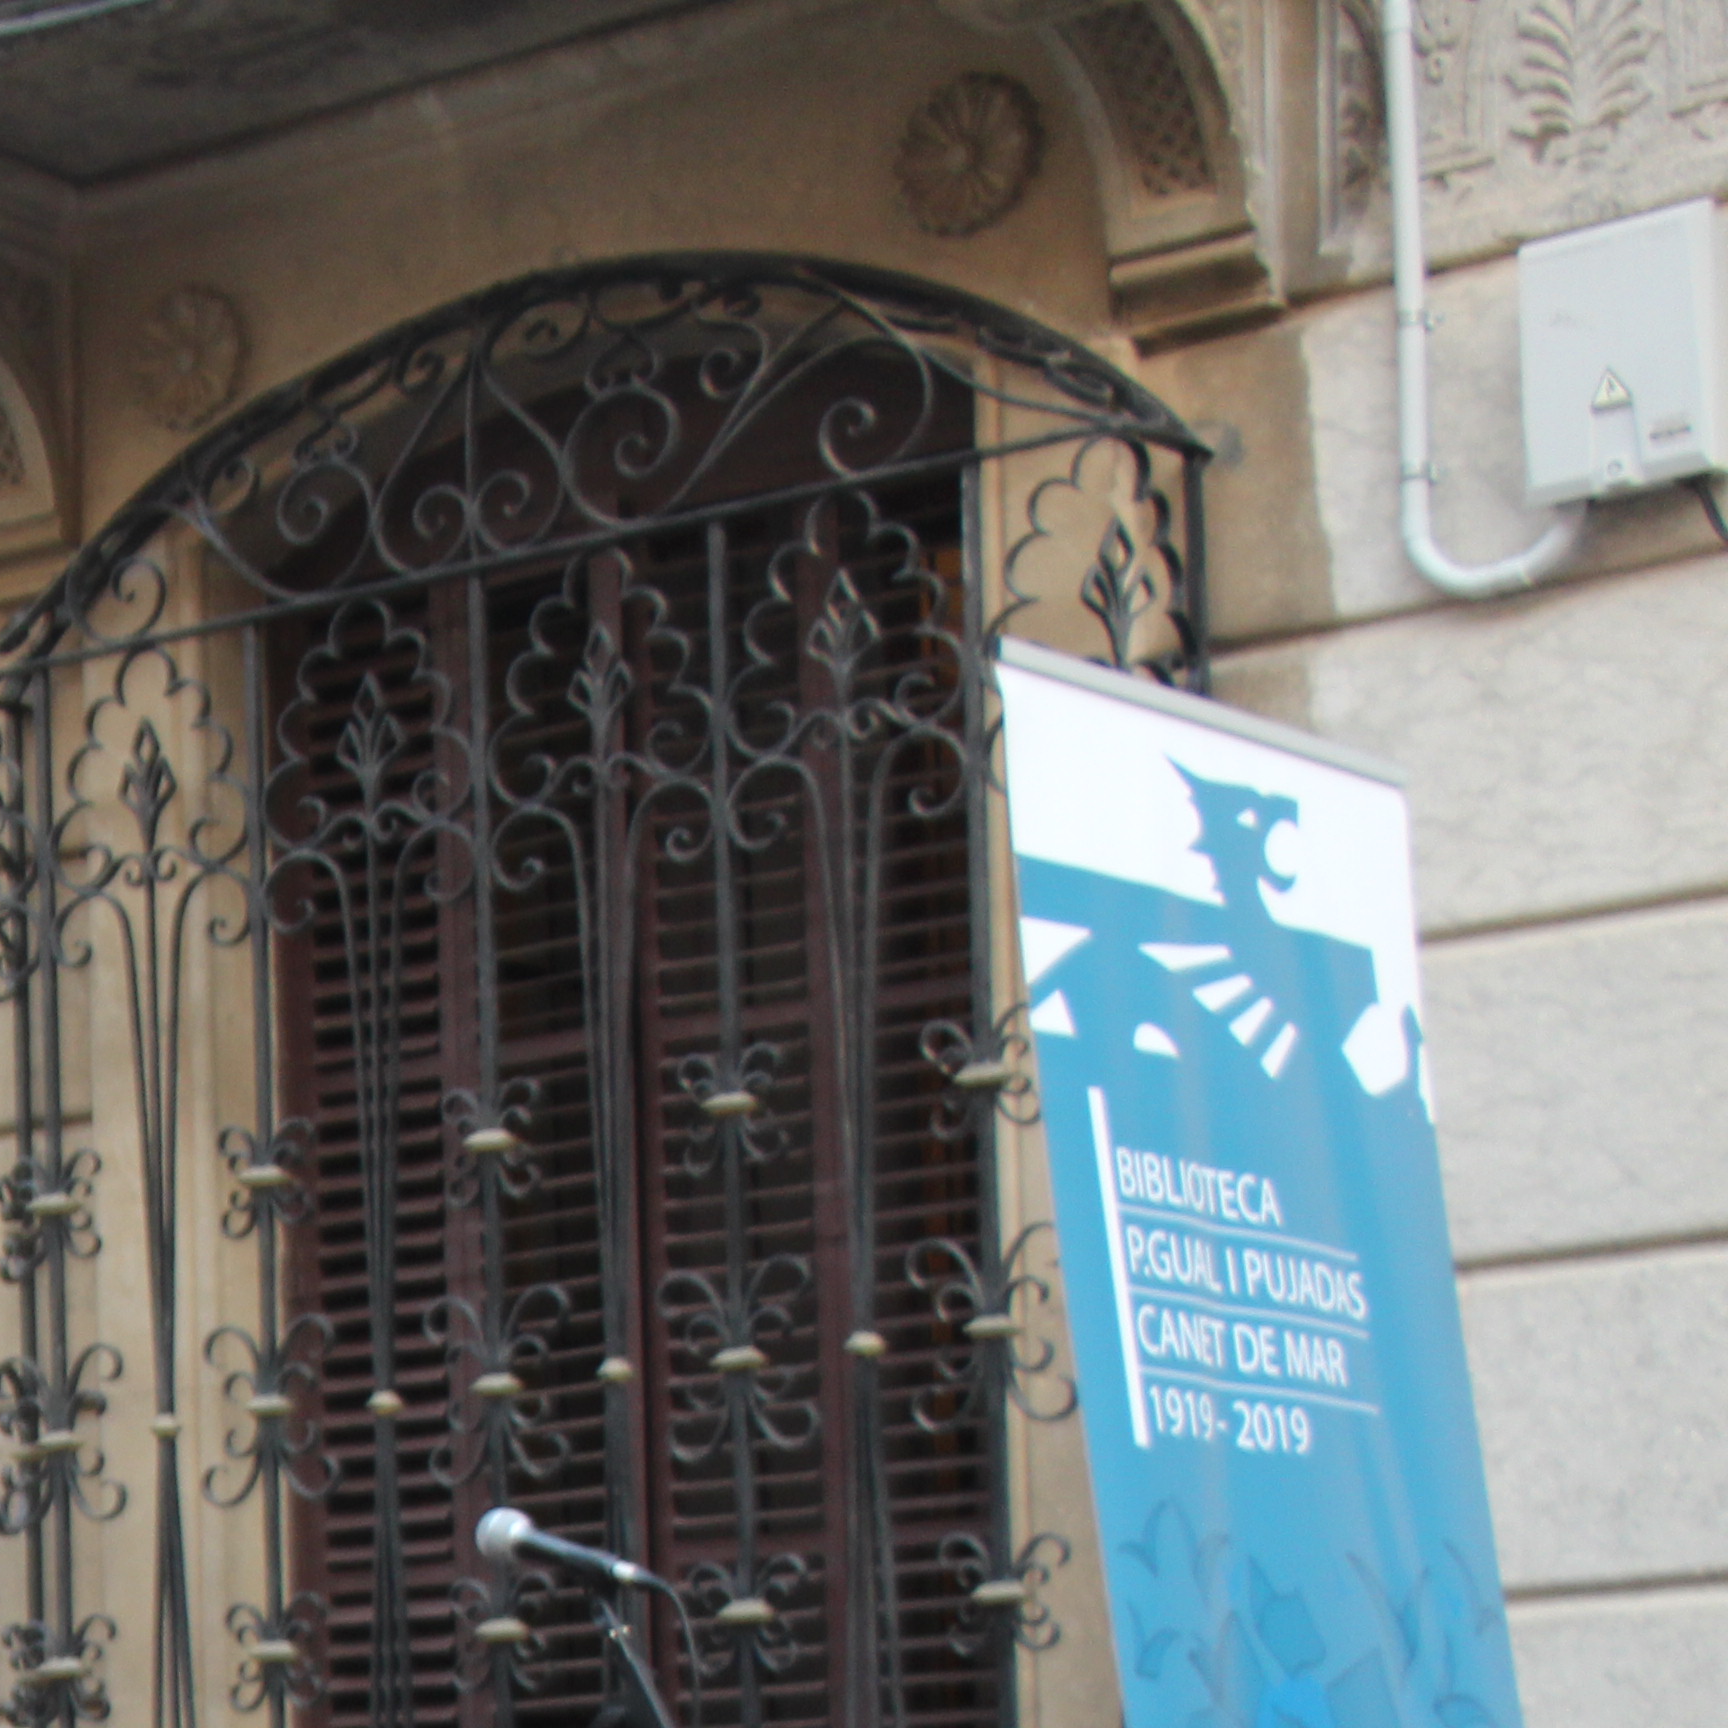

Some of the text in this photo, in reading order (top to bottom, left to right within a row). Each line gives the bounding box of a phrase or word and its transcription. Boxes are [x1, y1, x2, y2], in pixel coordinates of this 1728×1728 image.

[1116, 1146, 1285, 1226] BIBLIOTECA
[1126, 1224, 1369, 1321] P.GUAL I PUJADAS
[1138, 1304, 1350, 1388] CANET DE MAR
[1232, 1399, 1311, 1454] 2019
